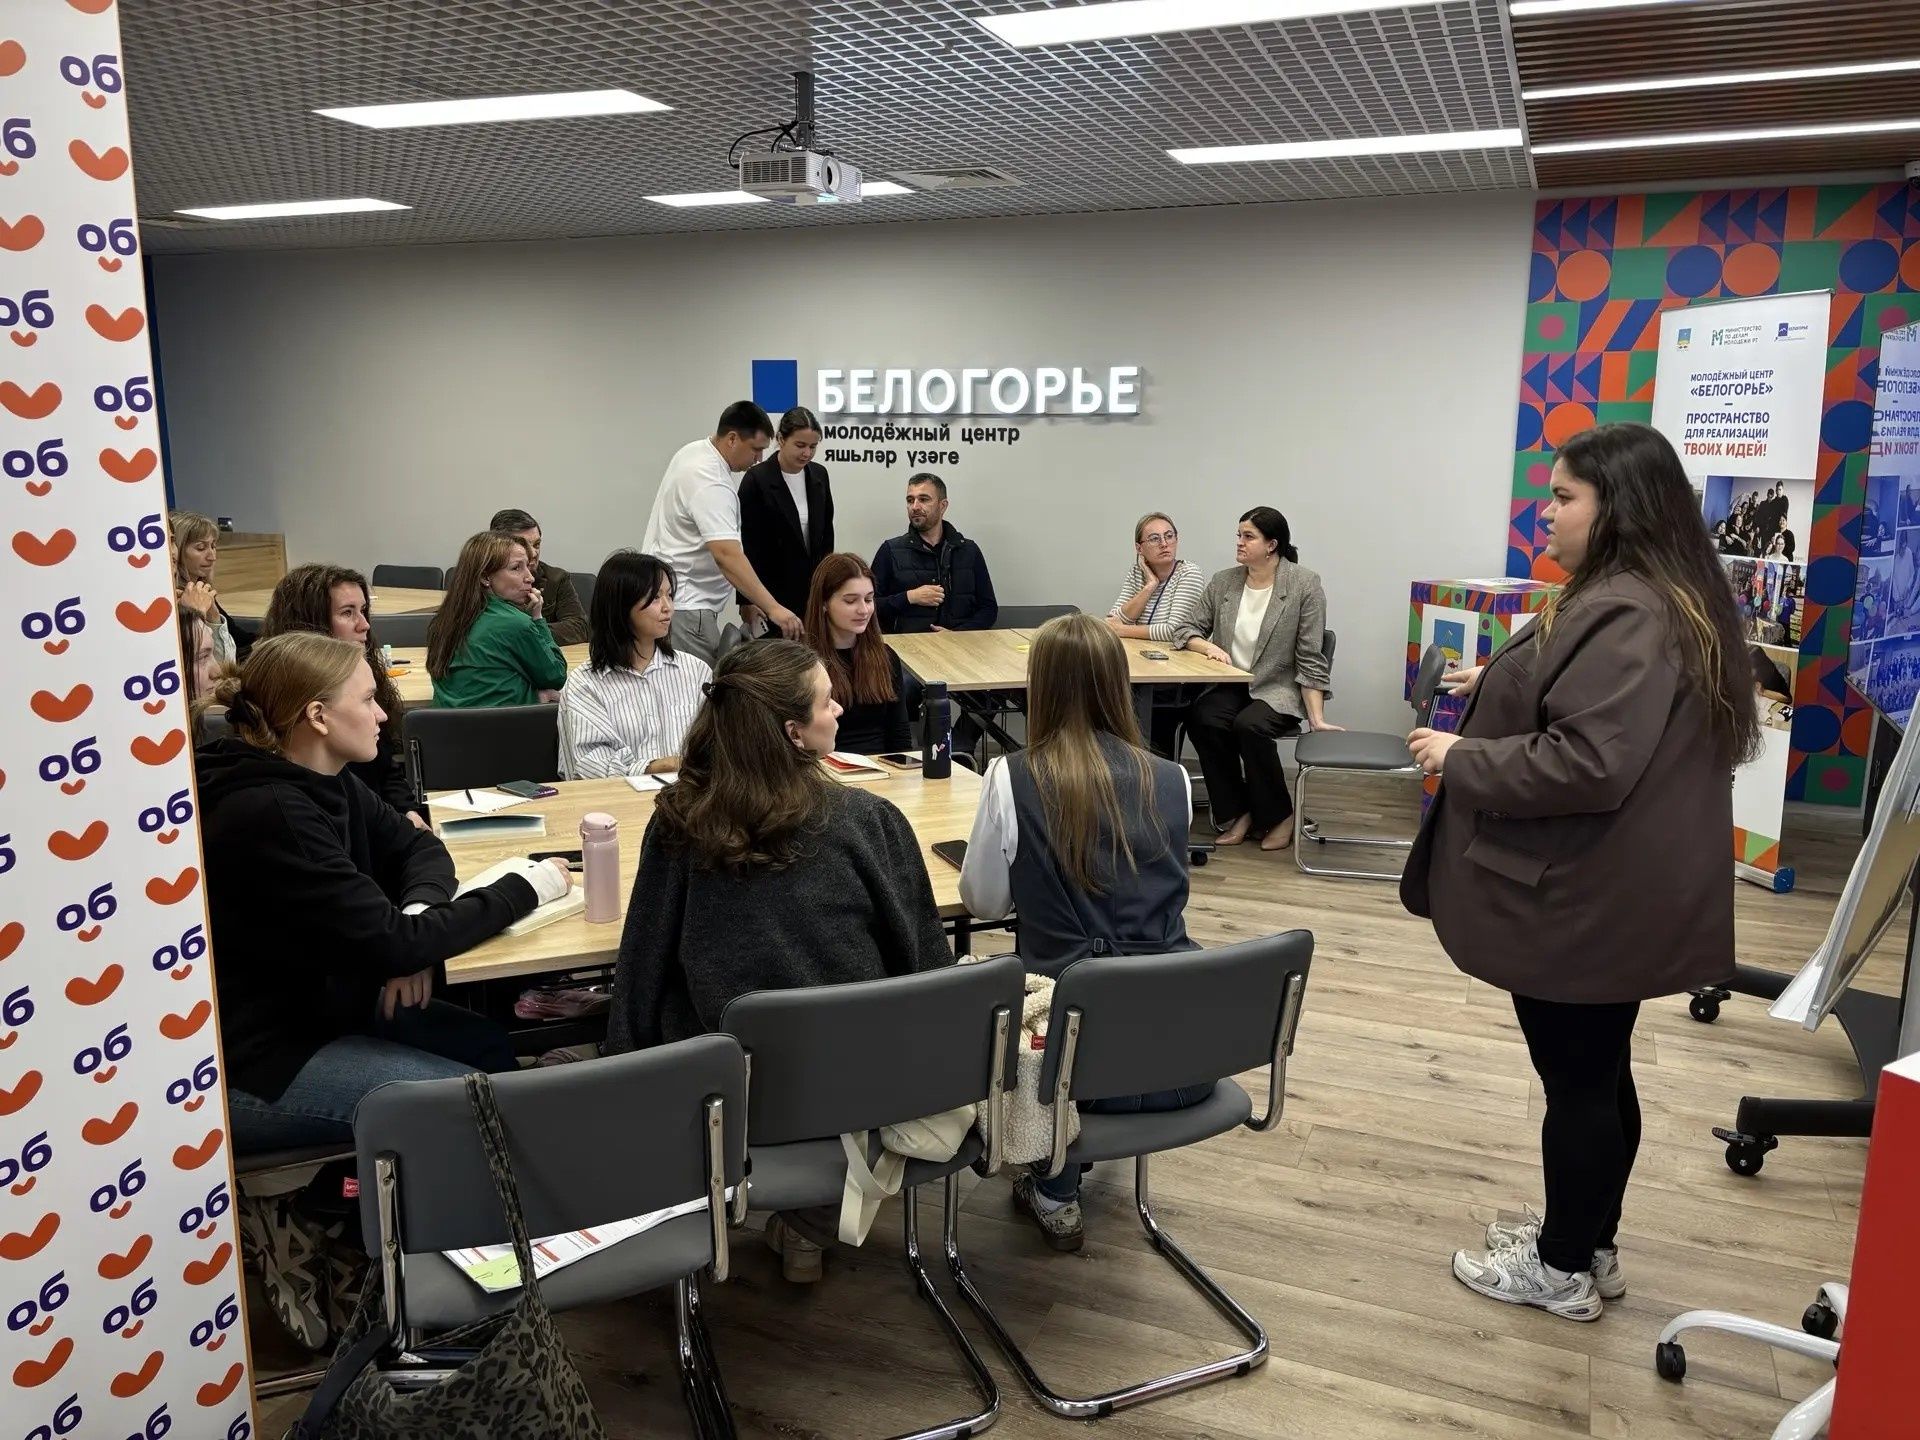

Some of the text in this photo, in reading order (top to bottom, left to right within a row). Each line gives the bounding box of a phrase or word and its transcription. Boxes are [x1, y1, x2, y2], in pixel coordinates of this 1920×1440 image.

[60, 55, 122, 93] об
[0, 118, 36, 158] б
[77, 219, 137, 255] об
[94, 376, 153, 412] об
[816, 366, 1140, 415] БЕЛОГОРЬЕ
[1690, 369, 1774, 382] МОЛОДЁЖНЫЙ ЦЕНТР
[1690, 382, 1774, 397] «БЕЛОГОРЬЕ»
[824, 422, 1020, 445] молодёжный центр
[1684, 428, 1769, 440] ДЛЯ РЕАЛИЗАЦИИ
[1686, 412, 1770, 424] ПРОСТРАНСТВО
[3, 439, 68, 477] об
[825, 448, 960, 468] яшьләр үзәге
[1683, 440, 1767, 458] ТВОИХ ИДЕЙ!
[107, 514, 165, 552] об
[21, 597, 85, 639] об
[123, 660, 180, 701] об
[39, 737, 101, 782] об
[138, 789, 193, 832] об
[57, 882, 117, 931] об
[153, 924, 206, 971] об
[0, 986, 35, 1026] б
[74, 1023, 132, 1074] об
[166, 1055, 218, 1104] об
[90, 1158, 146, 1212] об
[179, 1182, 230, 1233] об
[7, 1270, 69, 1331] об
[103, 1277, 157, 1333] об
[190, 1294, 239, 1347] об
[127, 1403, 171, 1440] б
